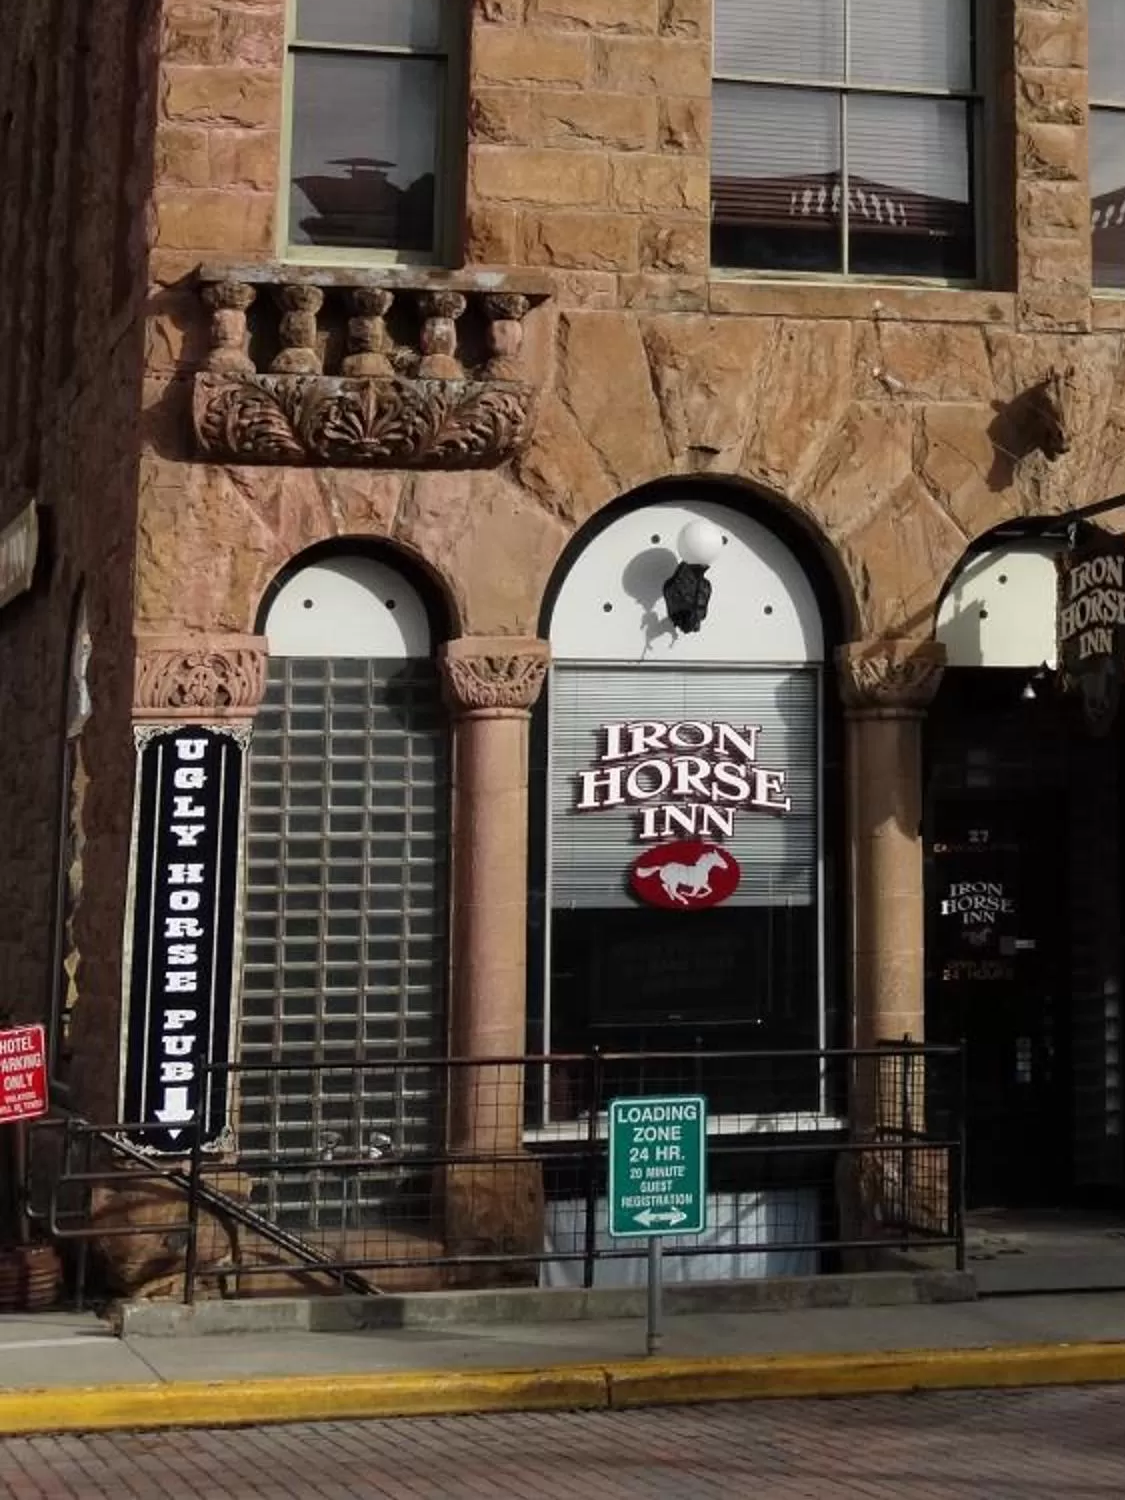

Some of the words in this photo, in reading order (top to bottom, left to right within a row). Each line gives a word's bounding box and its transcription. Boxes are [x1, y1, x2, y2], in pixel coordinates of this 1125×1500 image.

[1070, 556, 1124, 600] IRON
[1079, 627, 1113, 661] INN
[600, 720, 762, 761] IRON
[170, 738, 208, 847] UGLY
[576, 756, 791, 812] HORSE
[638, 803, 735, 839] INN
[949, 882, 1003, 898] IRON
[941, 896, 1015, 915] HORSE
[963, 911, 995, 924] INN
[164, 862, 205, 993] HORSE
[0, 1035, 36, 1054] HOTEL
[160, 1009, 197, 1082] PUB
[0, 1052, 41, 1073] ARKING
[4, 1071, 34, 1091] ONLY
[617, 1105, 697, 1123] LOADING
[633, 1125, 682, 1143] ZONE
[629, 1148, 649, 1163] 24
[655, 1146, 685, 1161] HR.
[629, 1168, 643, 1179] 20
[645, 1165, 686, 1178] MINUTE
[639, 1179, 673, 1193] GUEST
[621, 1193, 694, 1208] REGISTRATION
